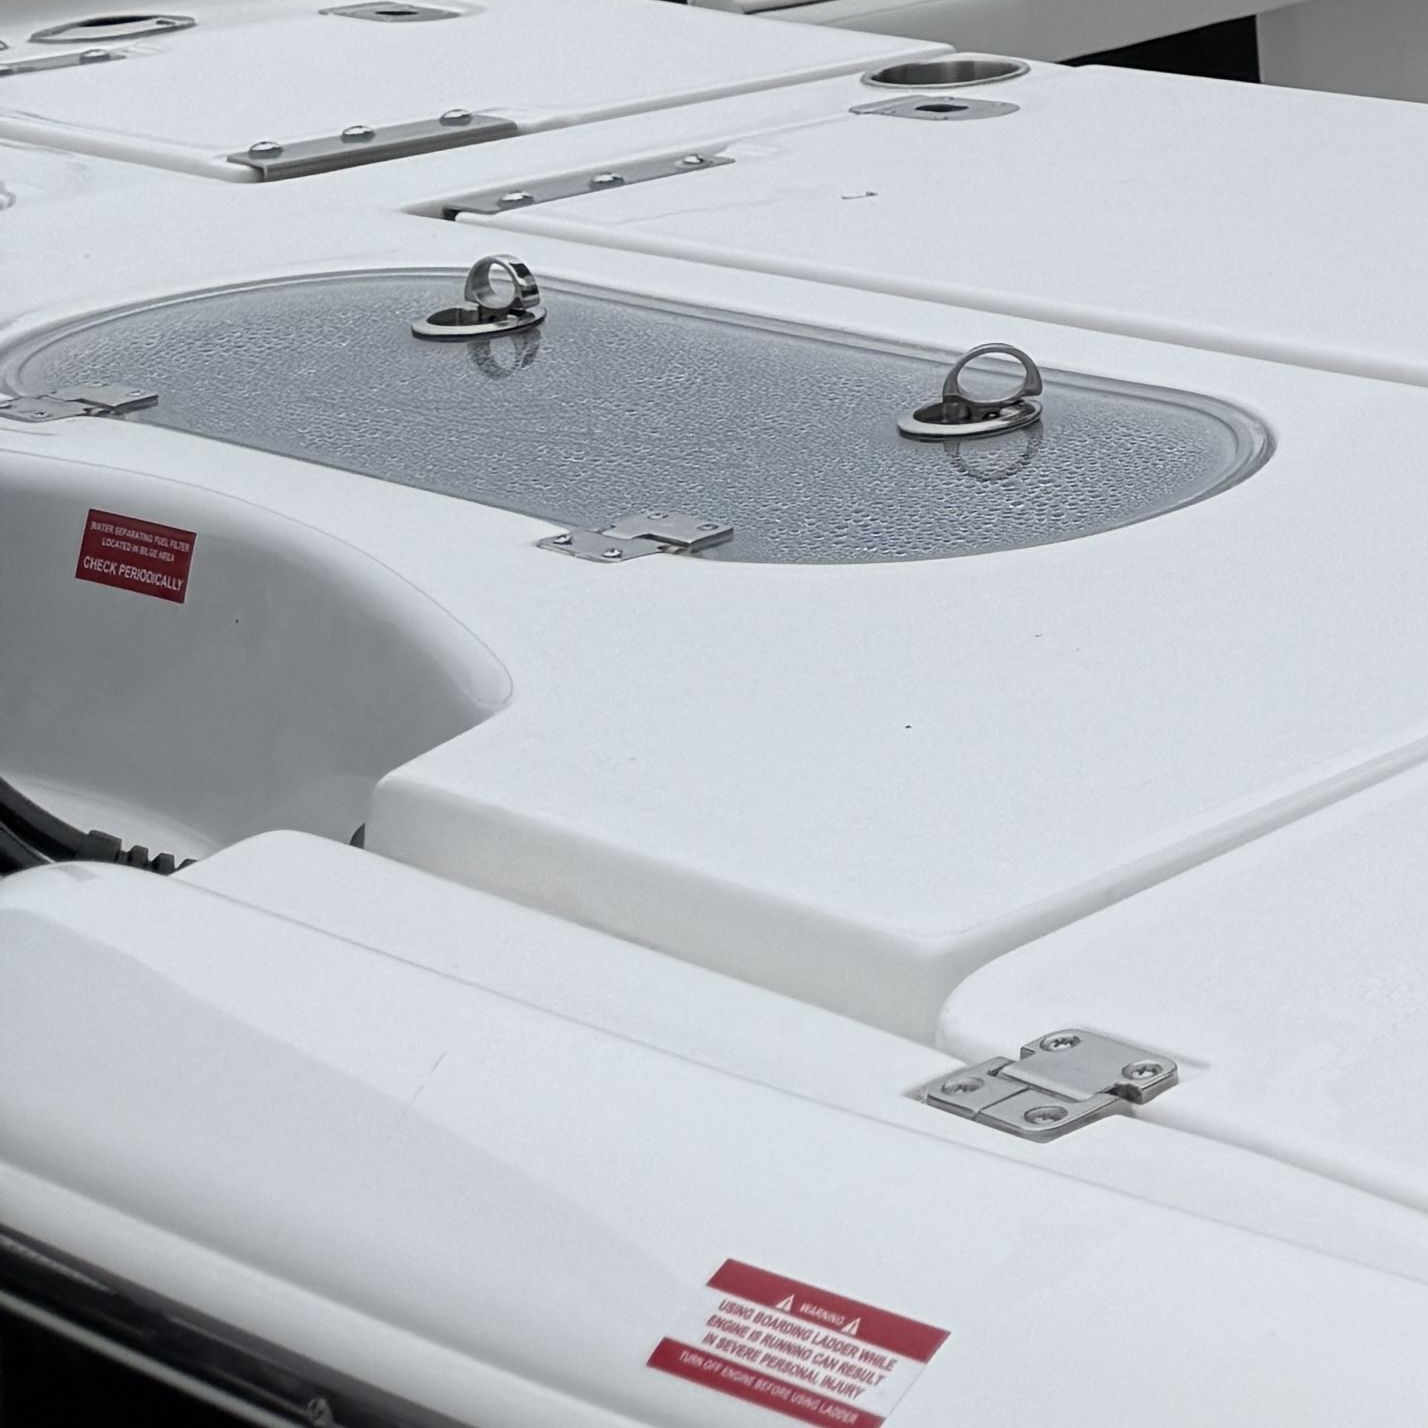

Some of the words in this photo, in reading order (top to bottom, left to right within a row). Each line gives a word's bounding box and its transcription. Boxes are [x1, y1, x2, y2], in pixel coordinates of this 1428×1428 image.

[90, 521, 114, 534] WATER
[115, 526, 153, 543] SEPARATING
[101, 537, 131, 552] LOCATED
[83, 556, 117, 576] CHECK
[118, 564, 184, 591] PERIODICALLY
[718, 1299, 754, 1320] USING
[752, 1311, 814, 1341] BOARDING
[811, 1332, 860, 1358] LADDER
[859, 1348, 898, 1372] WHILE
[800, 1302, 845, 1325] WARNING
[702, 1331, 718, 1346] IN
[715, 1337, 762, 1362] SEVERE
[759, 1353, 820, 1384] PERSONAL
[820, 1375, 866, 1400] INJURY
[706, 1314, 751, 1338] ENGINE
[747, 1330, 763, 1343] IS
[760, 1333, 813, 1361] RUNNING
[812, 1352, 839, 1371] CAN
[837, 1361, 886, 1387] RESULT
[680, 1350, 704, 1366] TURN
[703, 1359, 722, 1373] OFF
[721, 1366, 756, 1386] ENGINE
[753, 1379, 792, 1400] BEFORE
[790, 1392, 821, 1410] USING
[819, 1402, 860, 1425] LADDER
